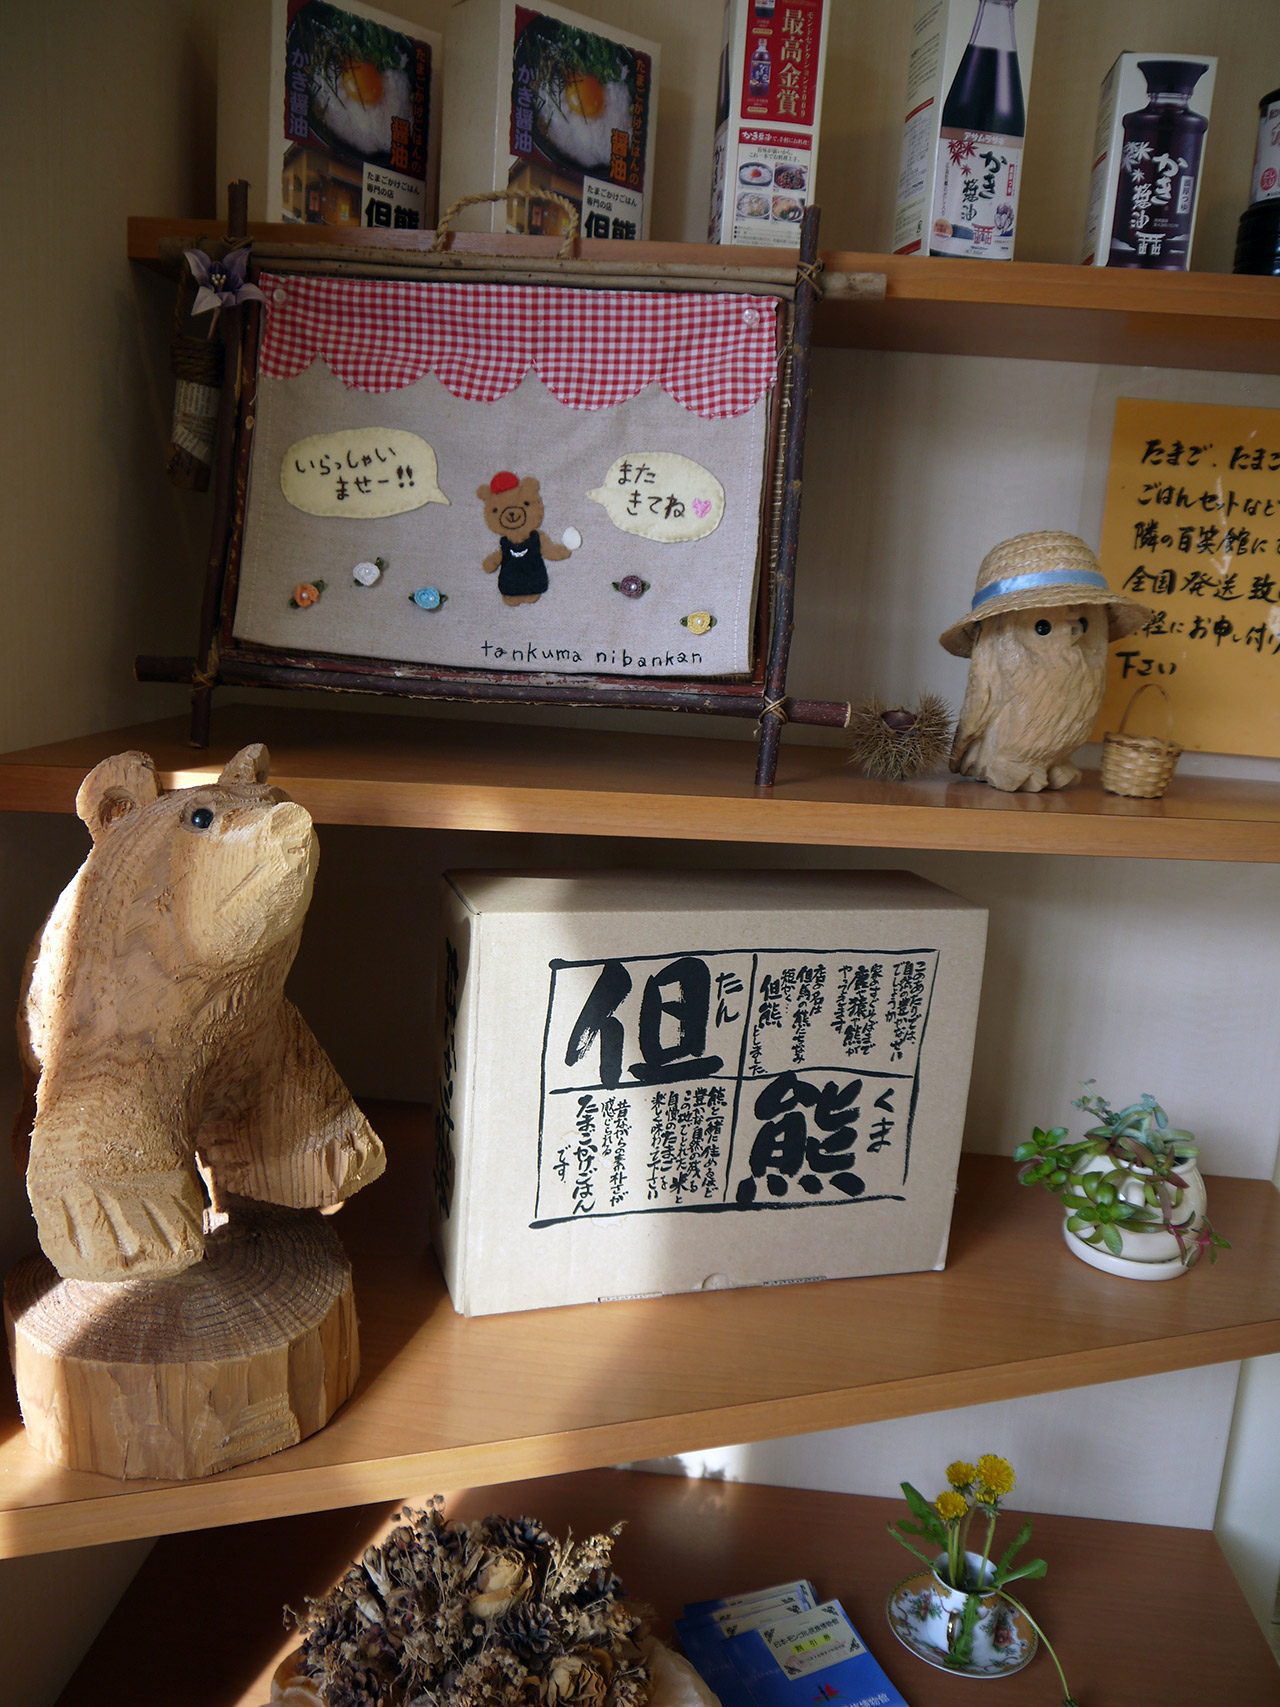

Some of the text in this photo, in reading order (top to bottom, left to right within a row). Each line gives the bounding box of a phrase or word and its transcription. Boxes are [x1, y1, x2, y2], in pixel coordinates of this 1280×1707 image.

[776, 8, 805, 116] 最高金賞
[288, 47, 309, 139] かき醤油
[410, 47, 428, 174] たまごかけごはんの
[514, 63, 535, 154] かき醤油
[390, 115, 411, 171] 醤油
[629, 58, 648, 185] たまごかけごはんの
[963, 131, 1006, 146] アサムラサキ
[609, 128, 631, 182] 醤油
[978, 149, 1008, 201] かき
[1150, 152, 1188, 206] かき
[365, 184, 395, 200] 専門の店
[366, 171, 421, 197] たまごかけごはん
[586, 198, 613, 212] 専門の店
[587, 184, 638, 207] たまごかけごはん
[294, 446, 398, 477] いらっしゃい
[617, 463, 656, 486] また
[626, 492, 686, 520] きてね
[1122, 564, 1280, 605] 全国発送致
[480, 640, 704, 669] tankuma nibankan
[1145, 609, 1280, 655] 軽にお申し付
[1115, 650, 1177, 680] 下さい
[714, 971, 744, 1029] たん
[758, 974, 783, 1029] 但熊
[809, 963, 827, 1017] 店の名は
[830, 964, 853, 1035] やってきます
[884, 961, 906, 1023] でしょうか
[564, 956, 725, 1091] 但
[600, 1096, 616, 1157] 感じられる
[660, 1090, 680, 1190] 自慢のたまごを
[669, 1089, 694, 1204] この地でとれた米と
[736, 1070, 866, 1204] 熊
[866, 1087, 896, 1154] くま
[572, 1094, 599, 1215] たまごかけごはん
[845, 1693, 890, 1707] 博物館
